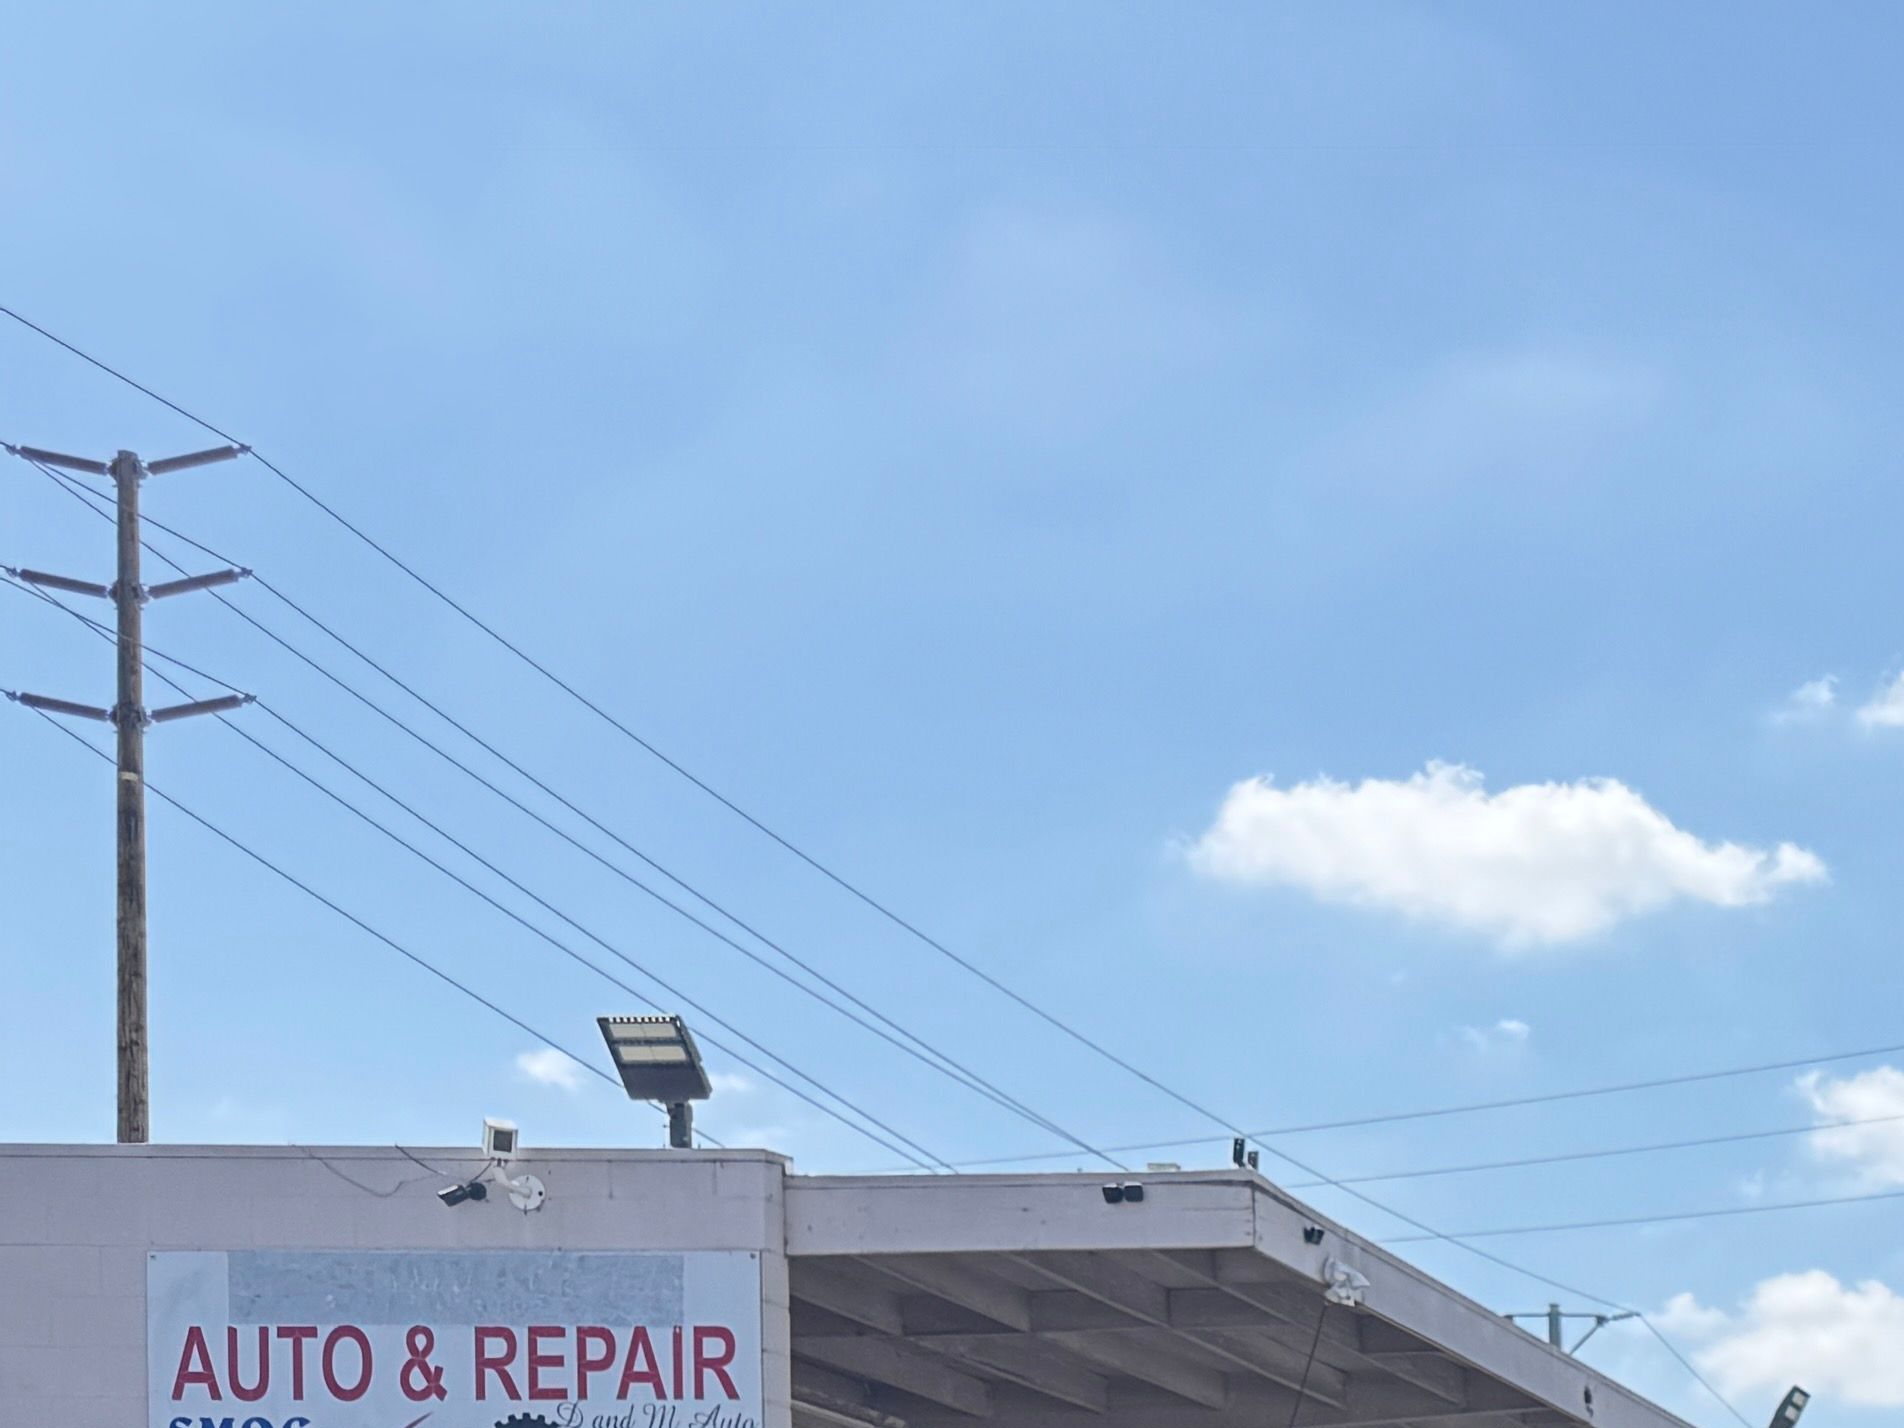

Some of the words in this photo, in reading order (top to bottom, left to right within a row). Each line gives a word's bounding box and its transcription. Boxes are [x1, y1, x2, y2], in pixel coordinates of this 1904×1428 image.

[171, 1325, 373, 1402] AUTO
[399, 1325, 448, 1402] &
[474, 1325, 741, 1401] REPAIR
